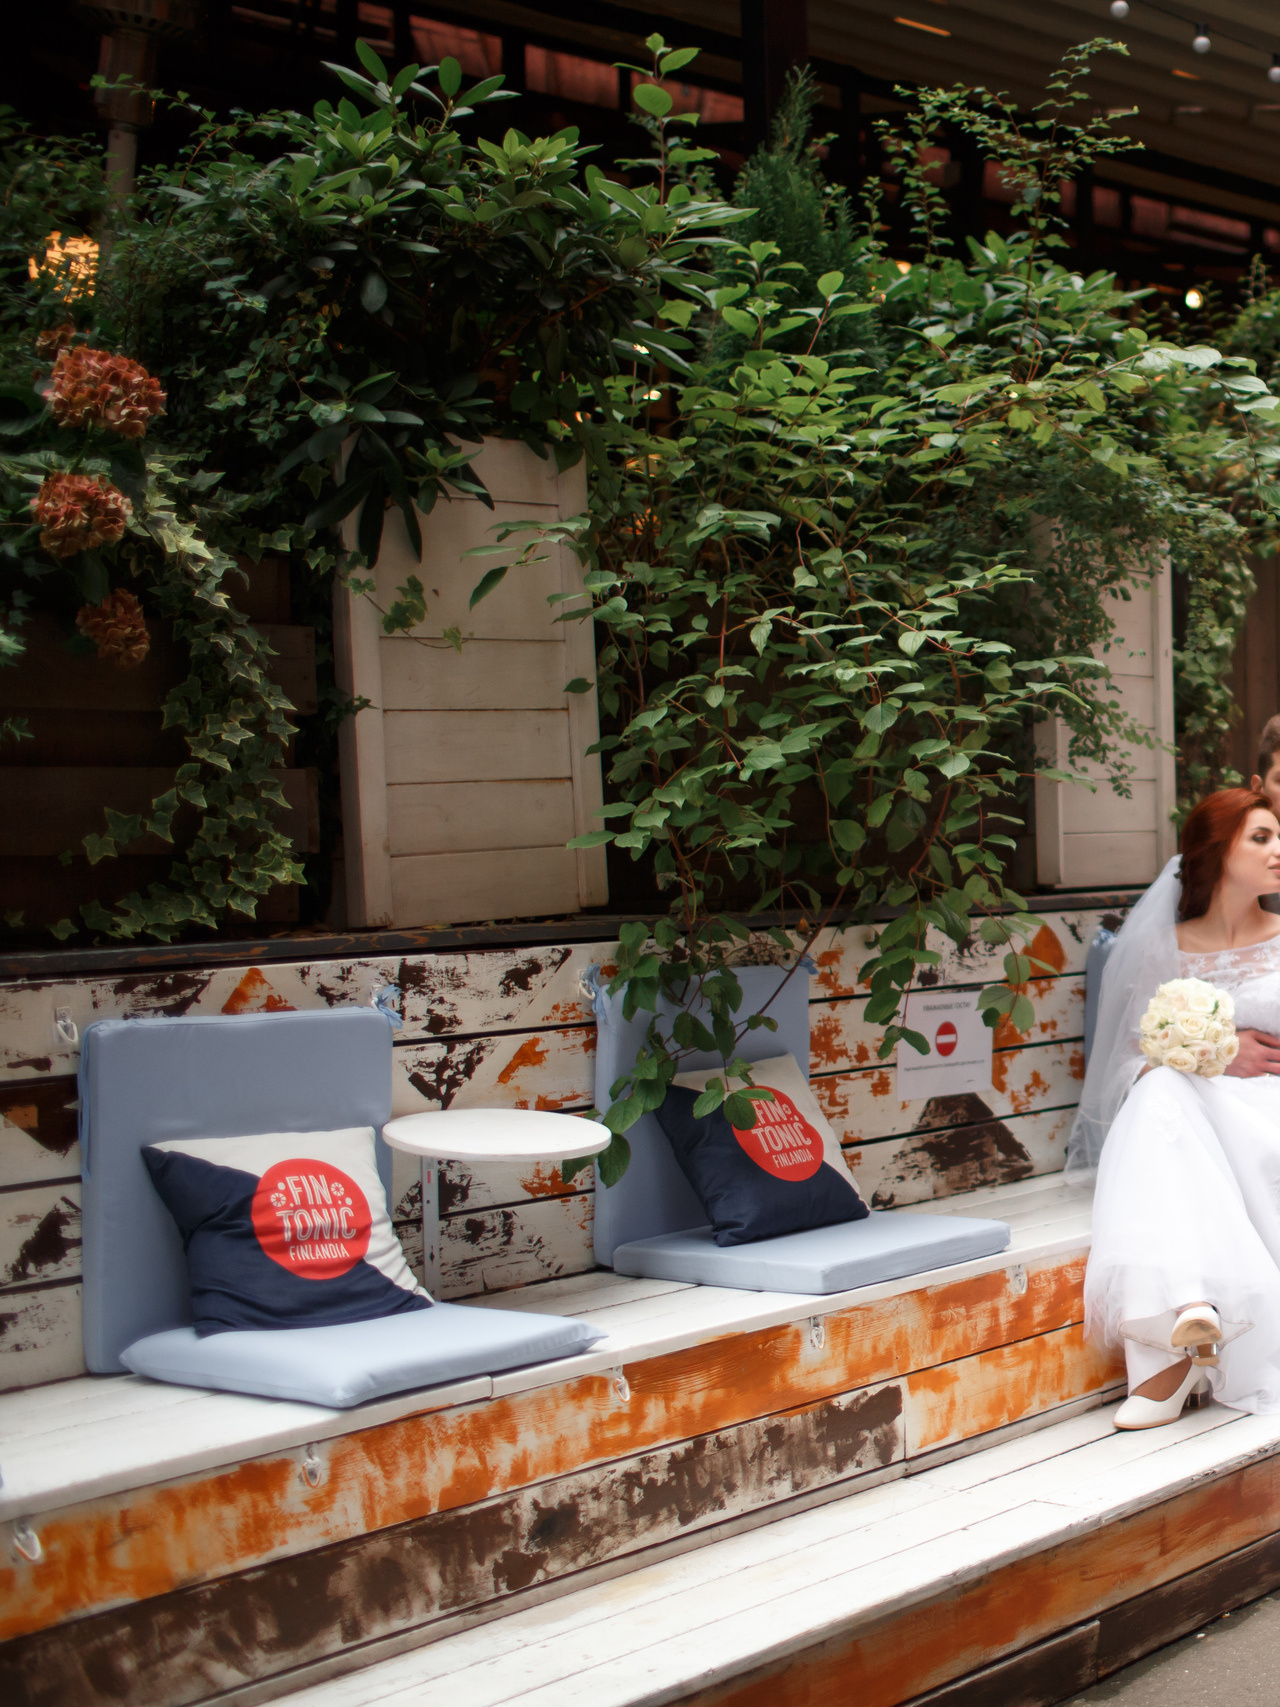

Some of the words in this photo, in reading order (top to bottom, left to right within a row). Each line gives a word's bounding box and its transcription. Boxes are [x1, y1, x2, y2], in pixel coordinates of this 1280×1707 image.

[752, 1098, 787, 1124] FIN
[751, 1122, 812, 1153] TONIC
[772, 1148, 814, 1168] FINLANDIA
[285, 1175, 332, 1206] FIN
[275, 1207, 356, 1242] TONIC
[289, 1243, 350, 1261] FINLANDIA
